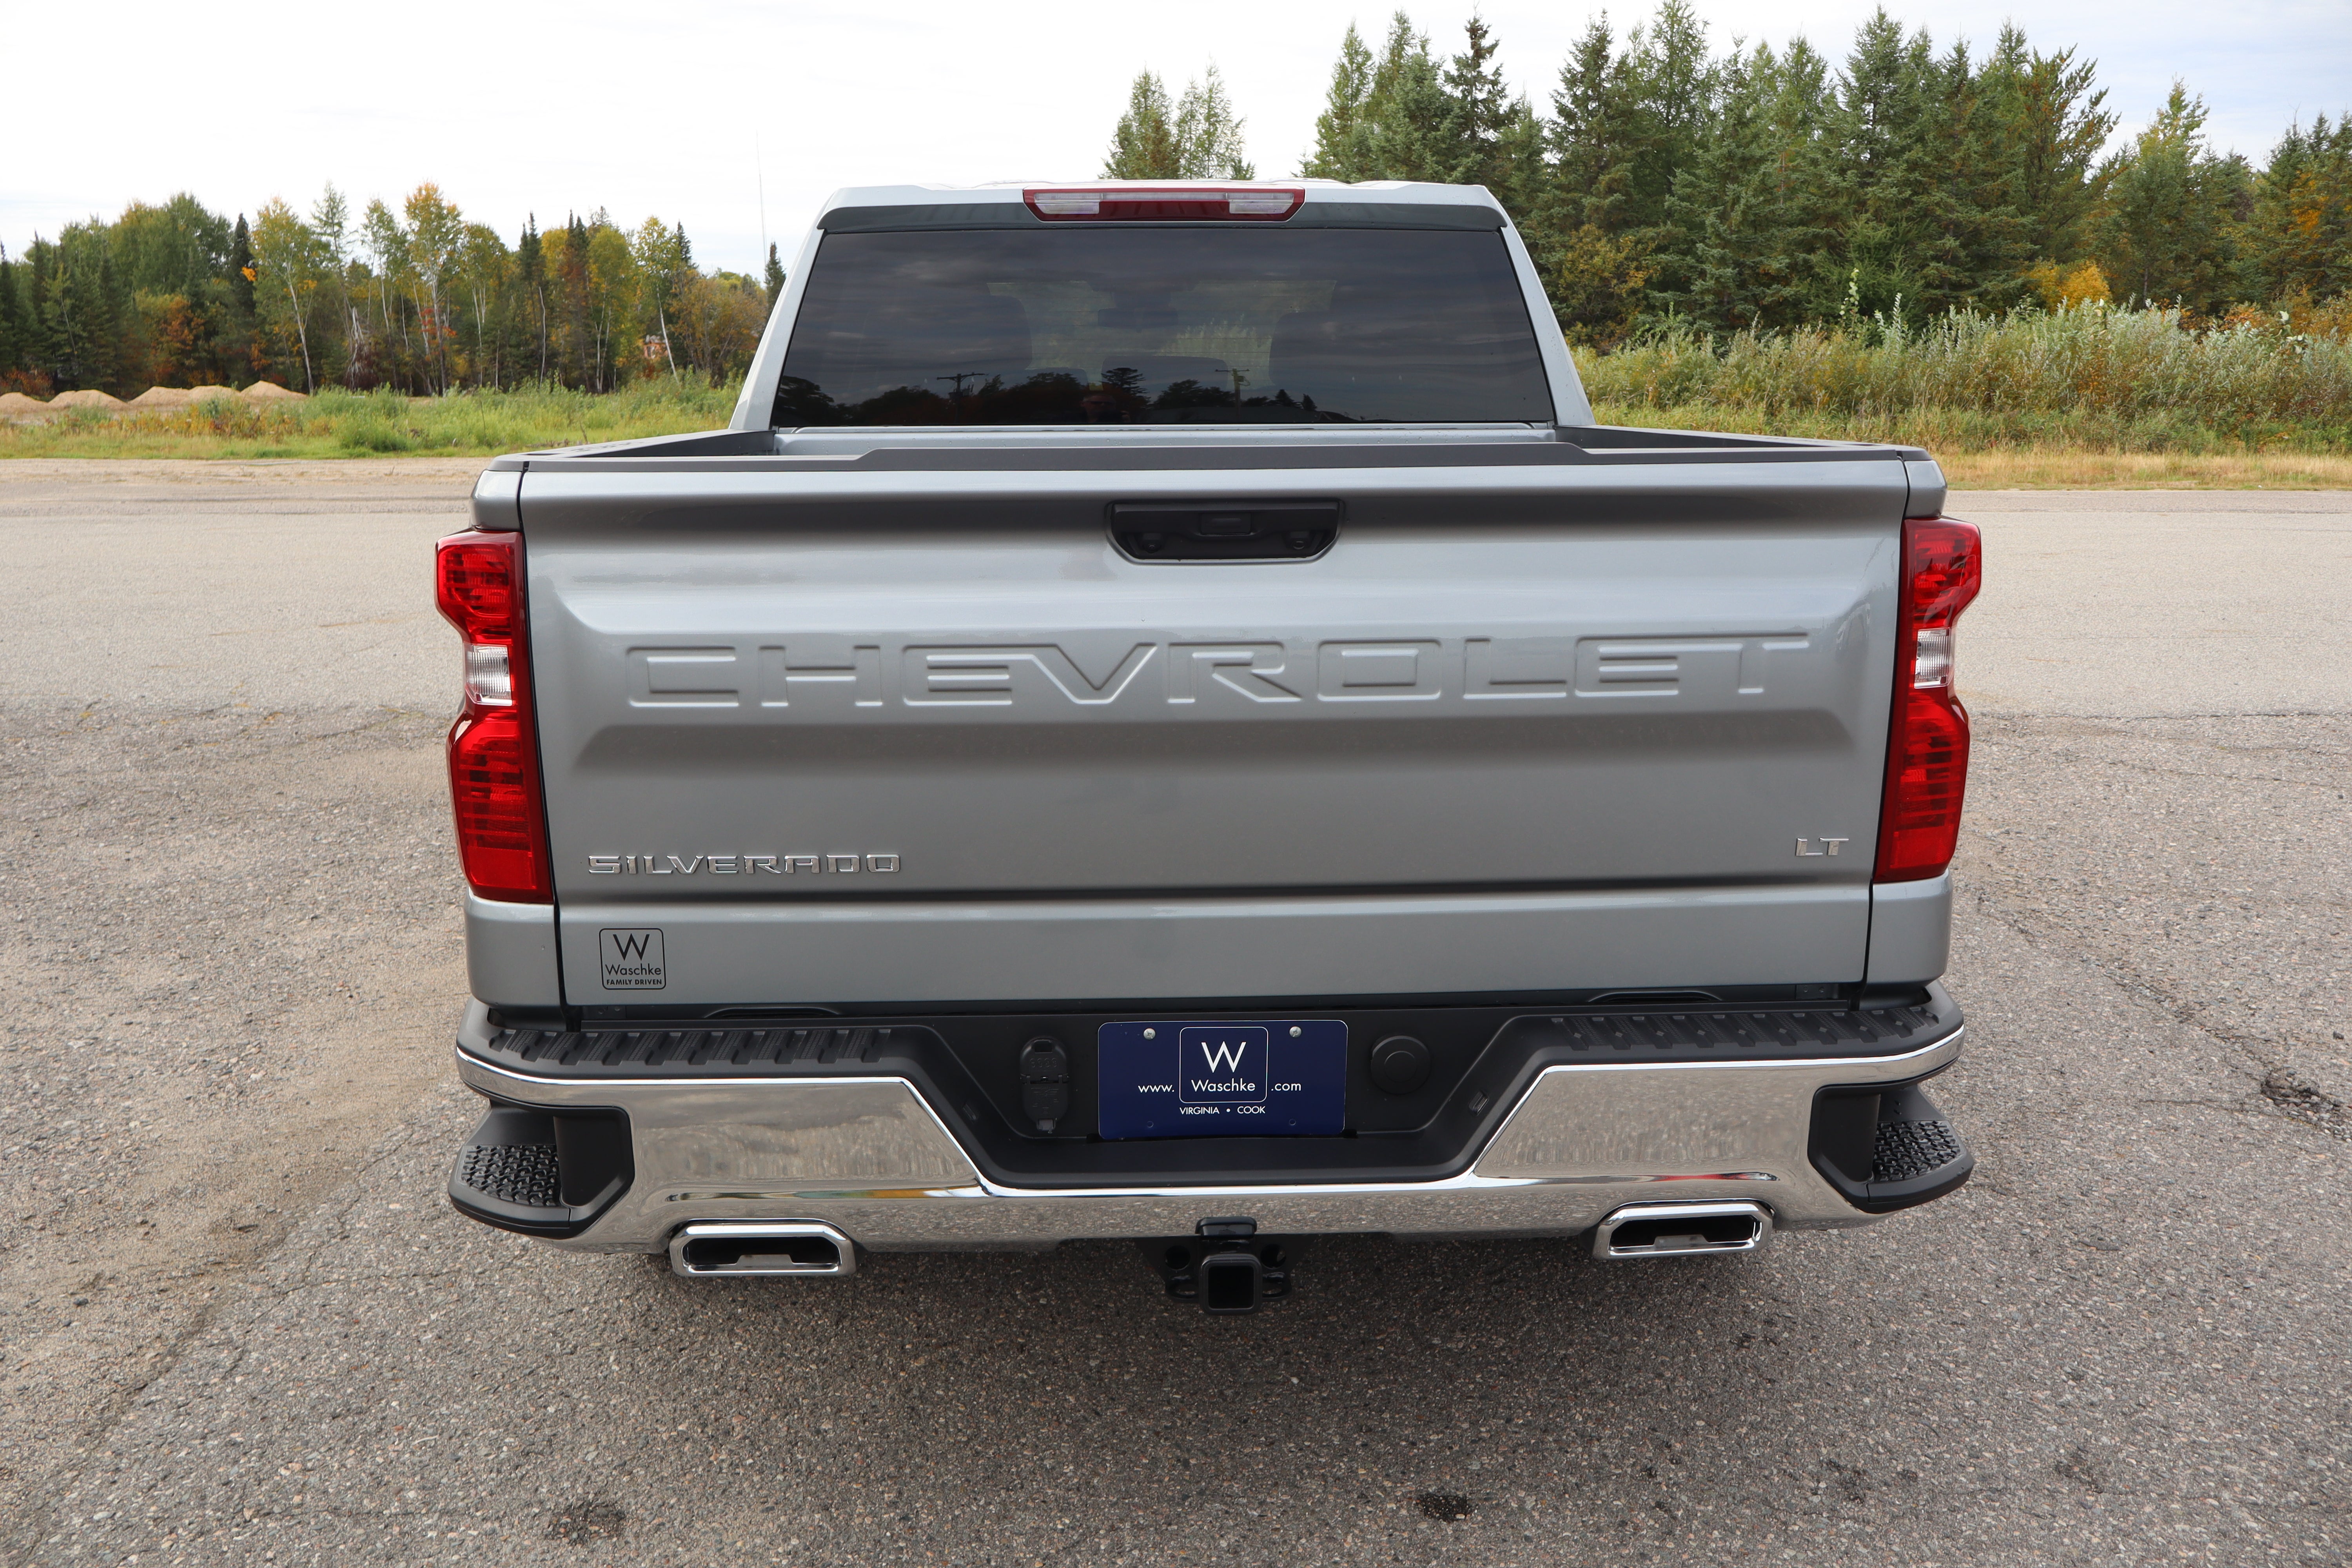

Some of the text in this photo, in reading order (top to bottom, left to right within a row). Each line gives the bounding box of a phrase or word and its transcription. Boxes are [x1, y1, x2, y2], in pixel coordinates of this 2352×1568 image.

[626, 632, 1809, 707] CHEVROLET
[1795, 837, 1849, 856] LT
[588, 854, 901, 874] SILVERADO
[613, 933, 650, 961] W
[605, 963, 661, 975] Waschke
[1201, 1041, 1246, 1073] W
[1138, 1078, 1301, 1093] www. Waschke .com
[1179, 1106, 1266, 1115] VIRGINIA COOK
